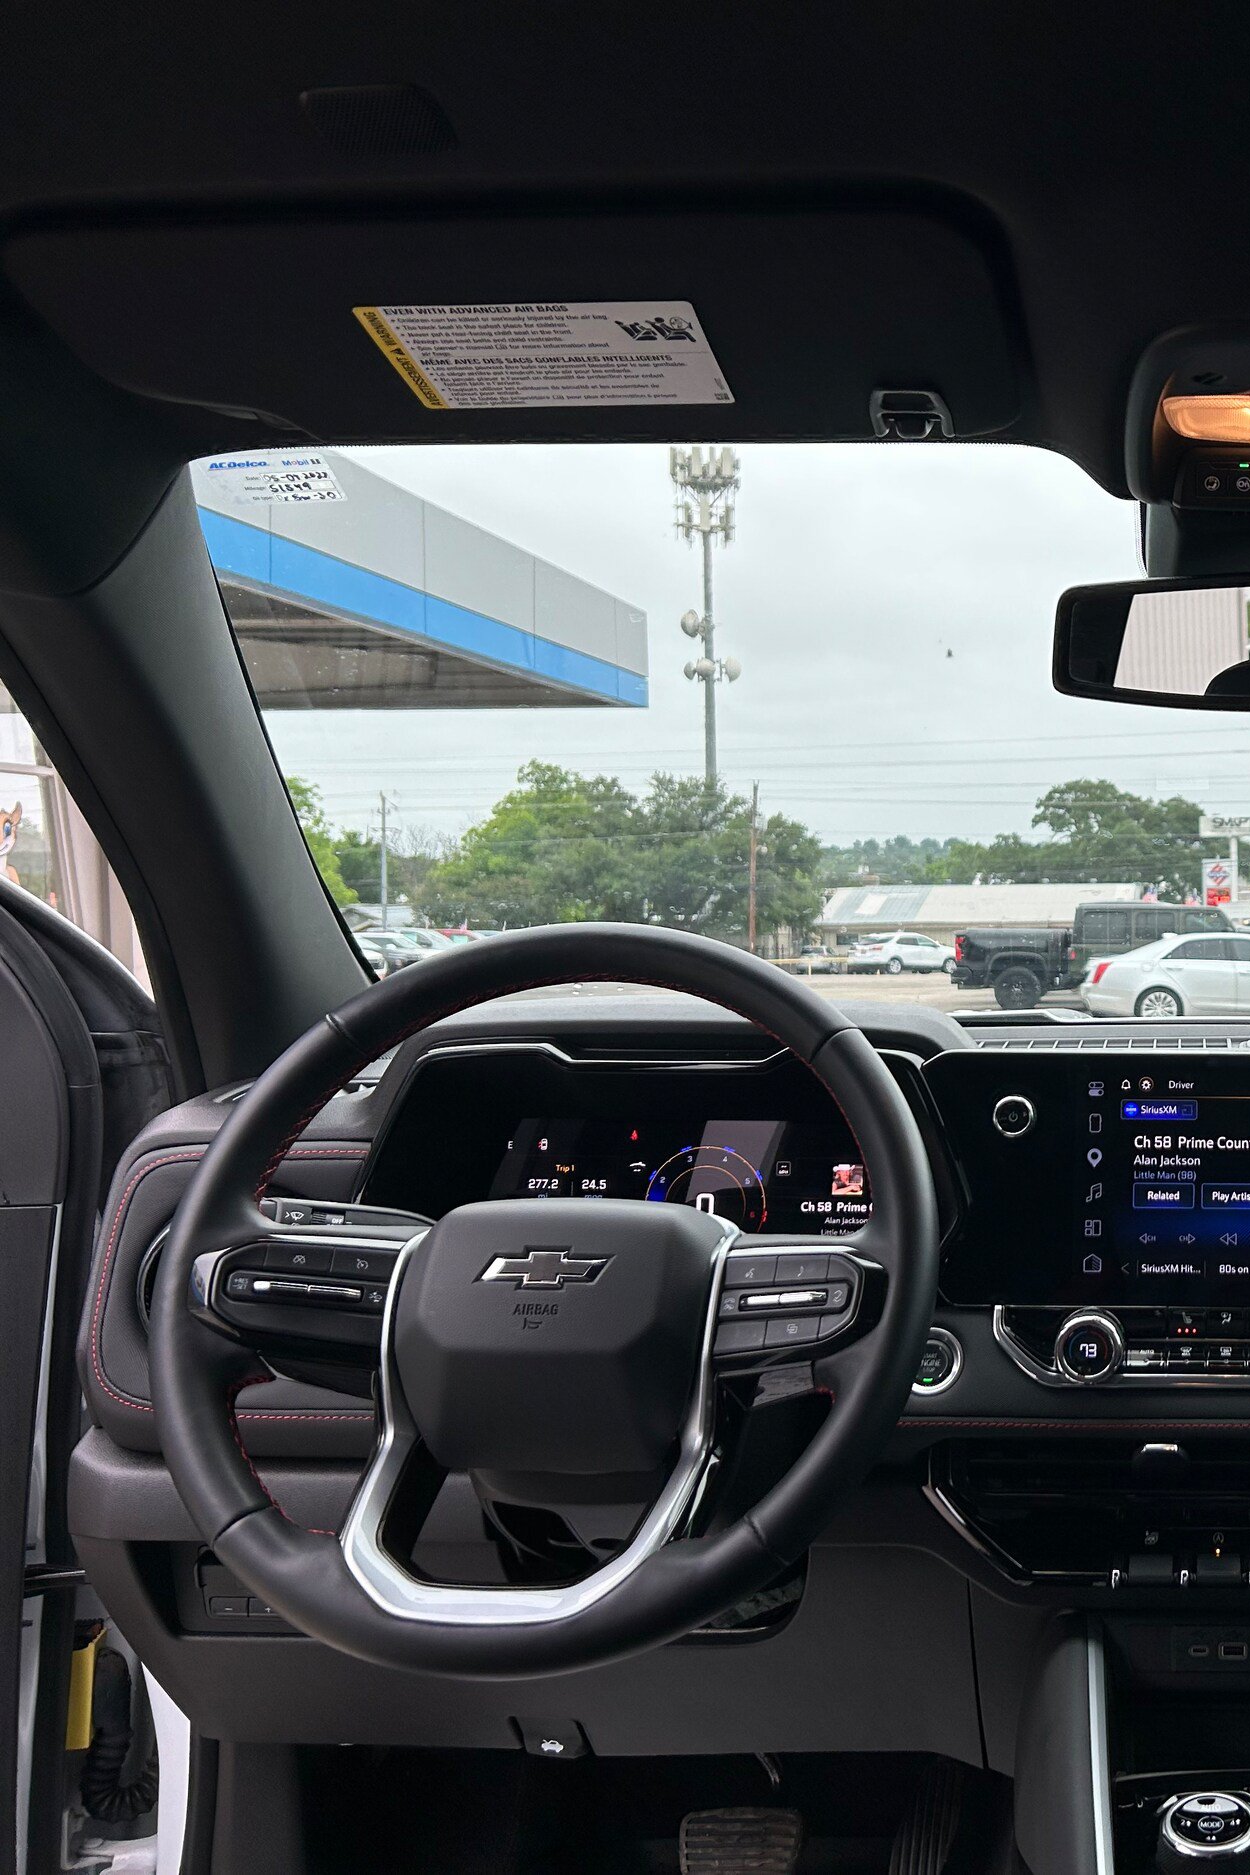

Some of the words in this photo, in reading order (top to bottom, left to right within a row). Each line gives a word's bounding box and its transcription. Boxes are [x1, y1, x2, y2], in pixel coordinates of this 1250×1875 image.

[450, 306, 512, 314] ADVANCED
[515, 305, 535, 313] AIR
[538, 304, 568, 312] BAGS
[454, 358, 482, 366] AVEC
[483, 357, 504, 365] DES
[535, 355, 600, 363] GONFLABLES
[602, 354, 673, 362] INTELLIGENTS
[209, 460, 267, 469] ACDelco
[282, 459, 309, 467] Mobil
[1169, 1080, 1194, 1089] Driver
[1141, 1105, 1177, 1114] SiriusXM
[507, 1140, 514, 1149] E
[1134, 1136, 1151, 1149] Ch
[1154, 1136, 1172, 1149] 58
[1178, 1136, 1214, 1149] Prime
[723, 1155, 729, 1163] 4
[1134, 1155, 1157, 1165] Alan
[1159, 1155, 1201, 1167] Jackson
[556, 1165, 570, 1173] Trip
[660, 1176, 666, 1184] 2
[1134, 1170, 1155, 1179] Little
[1157, 1171, 1175, 1180] Man
[1178, 1170, 1197, 1182] (98)
[528, 1178, 559, 1189] 277.2
[581, 1179, 607, 1190] 24.5
[1147, 1191, 1180, 1200] Related
[1212, 1191, 1229, 1203] Play
[800, 1202, 815, 1212] Ch
[817, 1202, 832, 1212] 58
[837, 1202, 867, 1212] Prime
[824, 1216, 841, 1224] Alan
[842, 1216, 869, 1226] Jackson
[821, 1228, 837, 1236] Little
[1141, 1263, 1179, 1274] SiriusXM
[1219, 1264, 1236, 1274] 80s
[1238, 1266, 1249, 1274] on
[513, 1303, 559, 1315] AIRBAG
[1079, 1343, 1097, 1358] 73
[921, 1359, 941, 1367] NGINE
[1200, 1820, 1223, 1829] MODE
